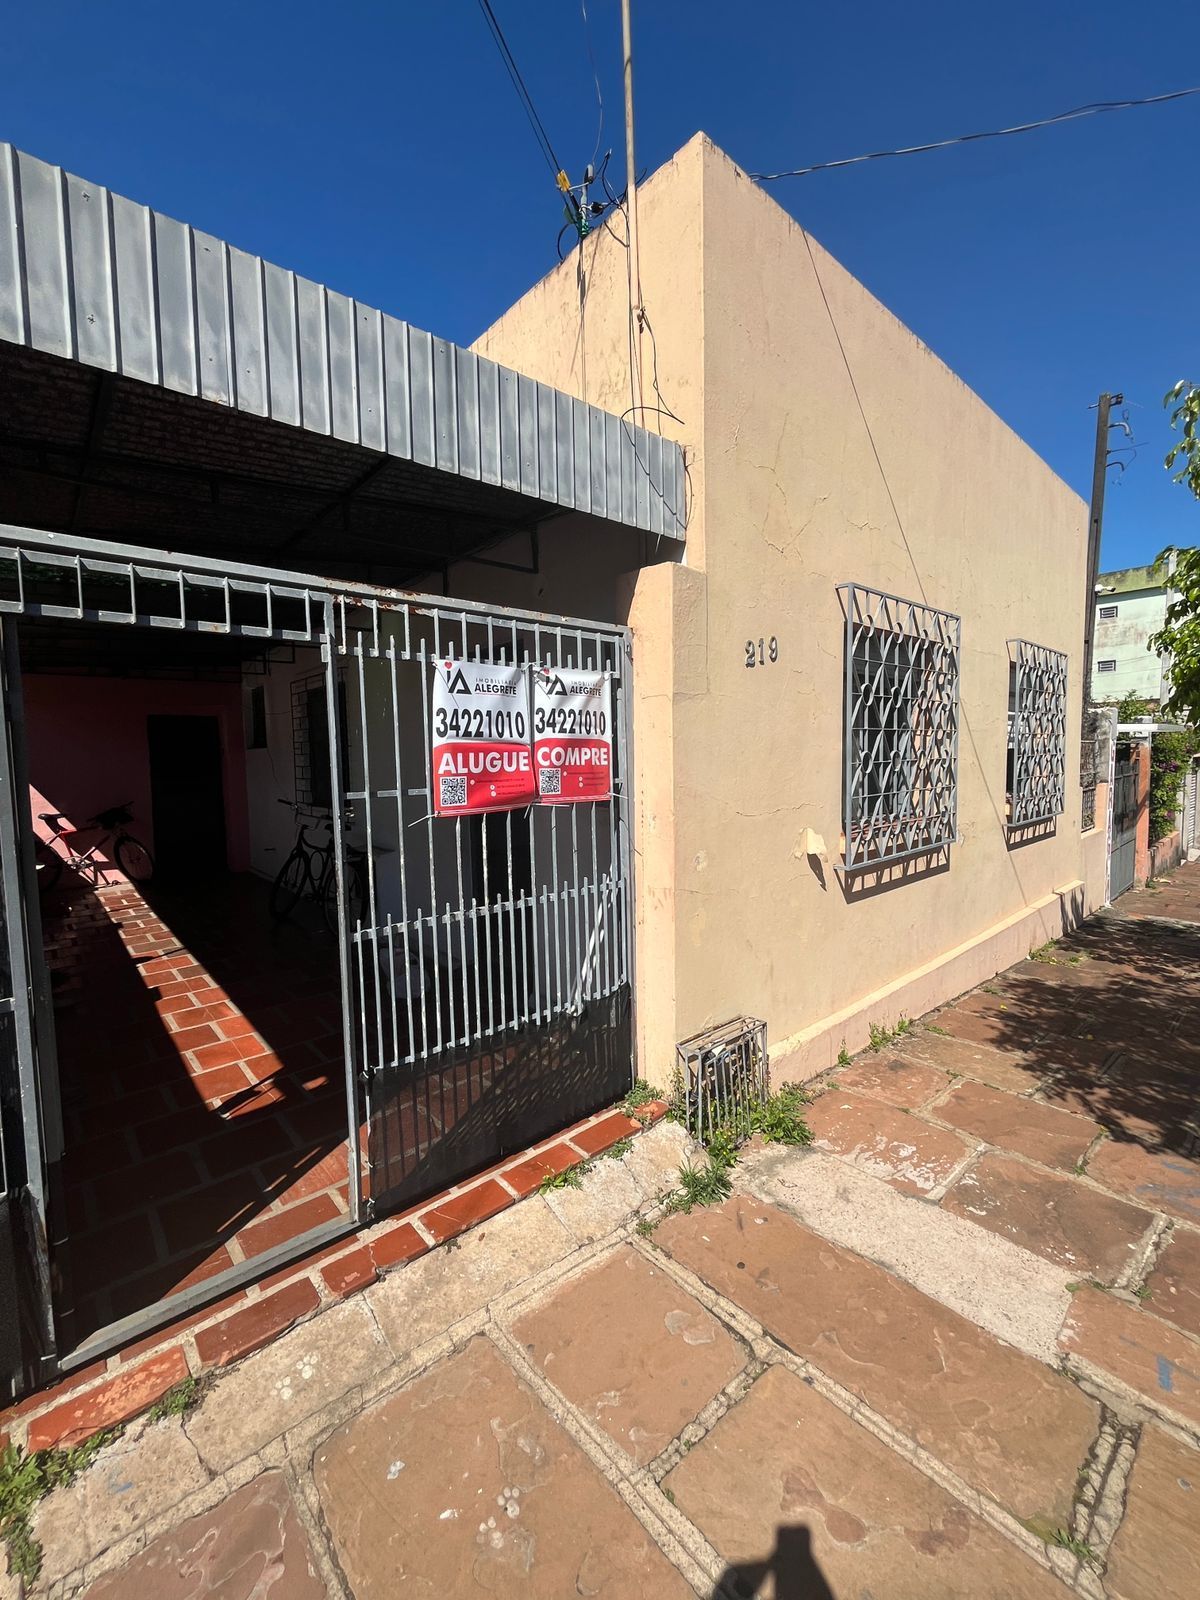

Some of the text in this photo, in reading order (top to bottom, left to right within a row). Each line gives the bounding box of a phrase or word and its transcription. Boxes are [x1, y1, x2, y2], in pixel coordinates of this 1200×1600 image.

[745, 636, 778, 668] 219
[474, 683, 517, 695] ALEGRETE
[569, 686, 602, 696] ALEGRETE
[435, 707, 525, 739] 34221010
[535, 707, 606, 736] 34221010
[438, 751, 530, 775] ALUGUE
[537, 746, 608, 767] COMPRE
